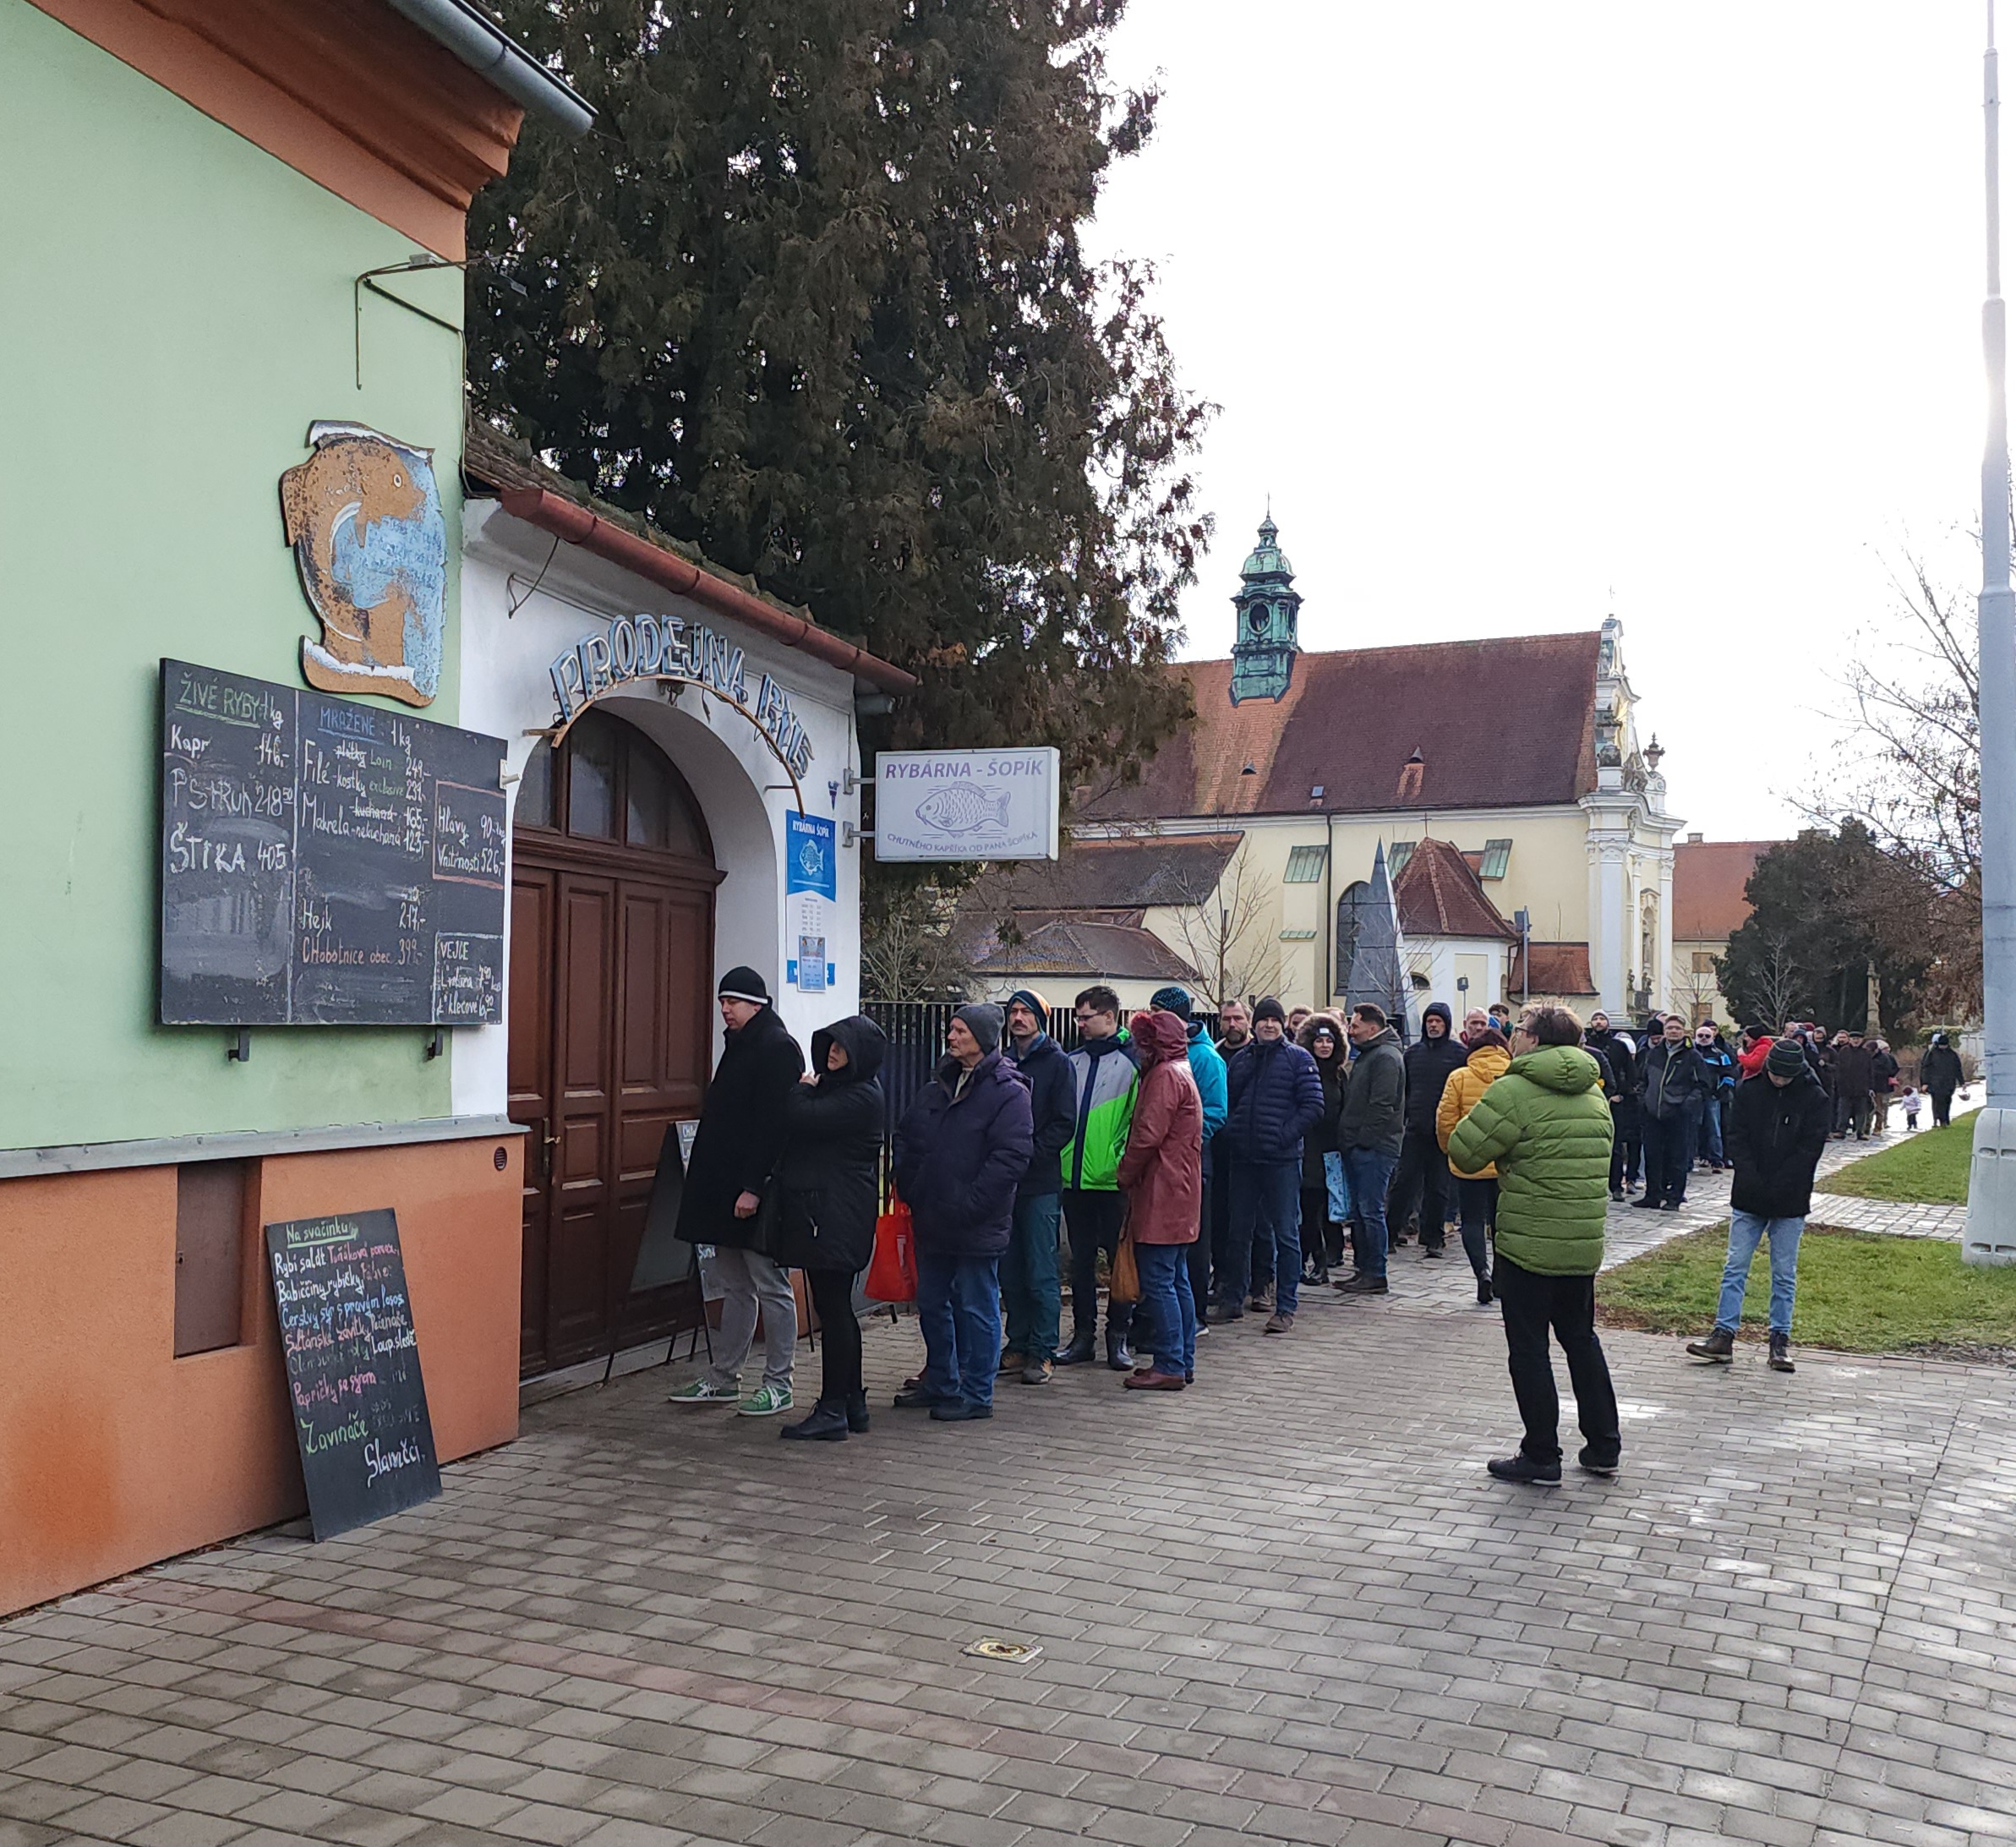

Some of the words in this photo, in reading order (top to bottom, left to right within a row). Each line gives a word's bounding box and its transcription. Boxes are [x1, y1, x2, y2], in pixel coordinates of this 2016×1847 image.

[549, 615, 748, 723] PRODEJNA
[180, 671, 218, 709] ŽIVÉ
[172, 724, 210, 759] Kapr
[303, 738, 330, 784] Filé
[885, 759, 971, 779] RYBÁRNA
[986, 757, 1044, 777] ŠOPÍK
[438, 805, 469, 848] Hlavy
[888, 833, 932, 851] CHUTNÉHO
[934, 844, 967, 853] KAPŘÍKA
[985, 841, 1006, 851] PANA
[1008, 831, 1038, 846] ŠOPÍKA
[303, 898, 332, 937] Hejk
[440, 940, 469, 960] VEJCE
[286, 1224, 301, 1243] Na
[275, 1251, 298, 1277] Rybí
[281, 1303, 320, 1330] Čerstvý
[338, 1378, 348, 1393] se
[300, 1410, 369, 1456] Zavináče
